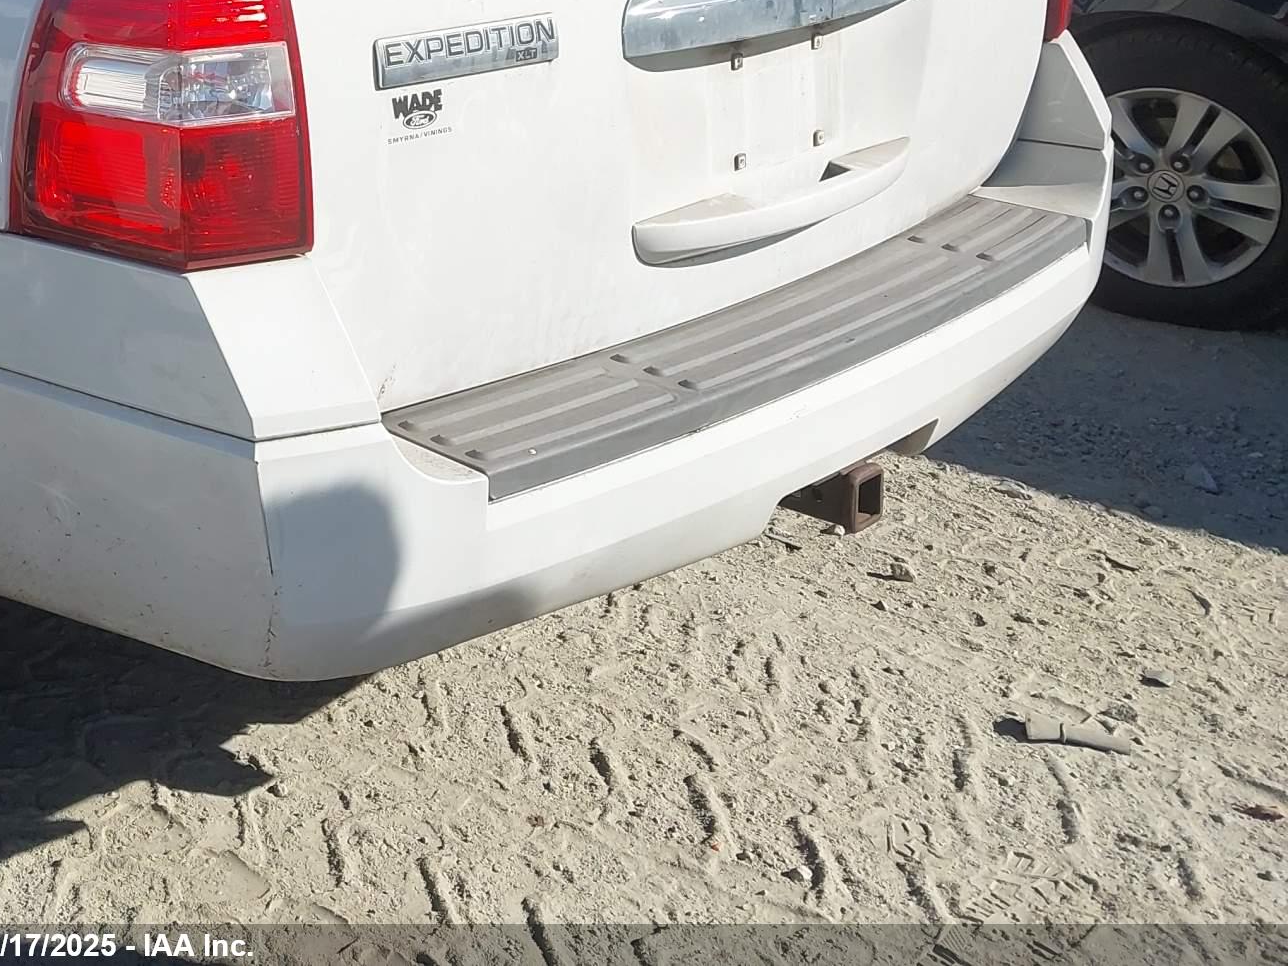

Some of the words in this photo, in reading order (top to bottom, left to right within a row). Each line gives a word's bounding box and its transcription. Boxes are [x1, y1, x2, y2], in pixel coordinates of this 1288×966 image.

[384, 18, 556, 67] EXPEDITION
[516, 47, 537, 62] XLT
[392, 88, 443, 119] WADE
